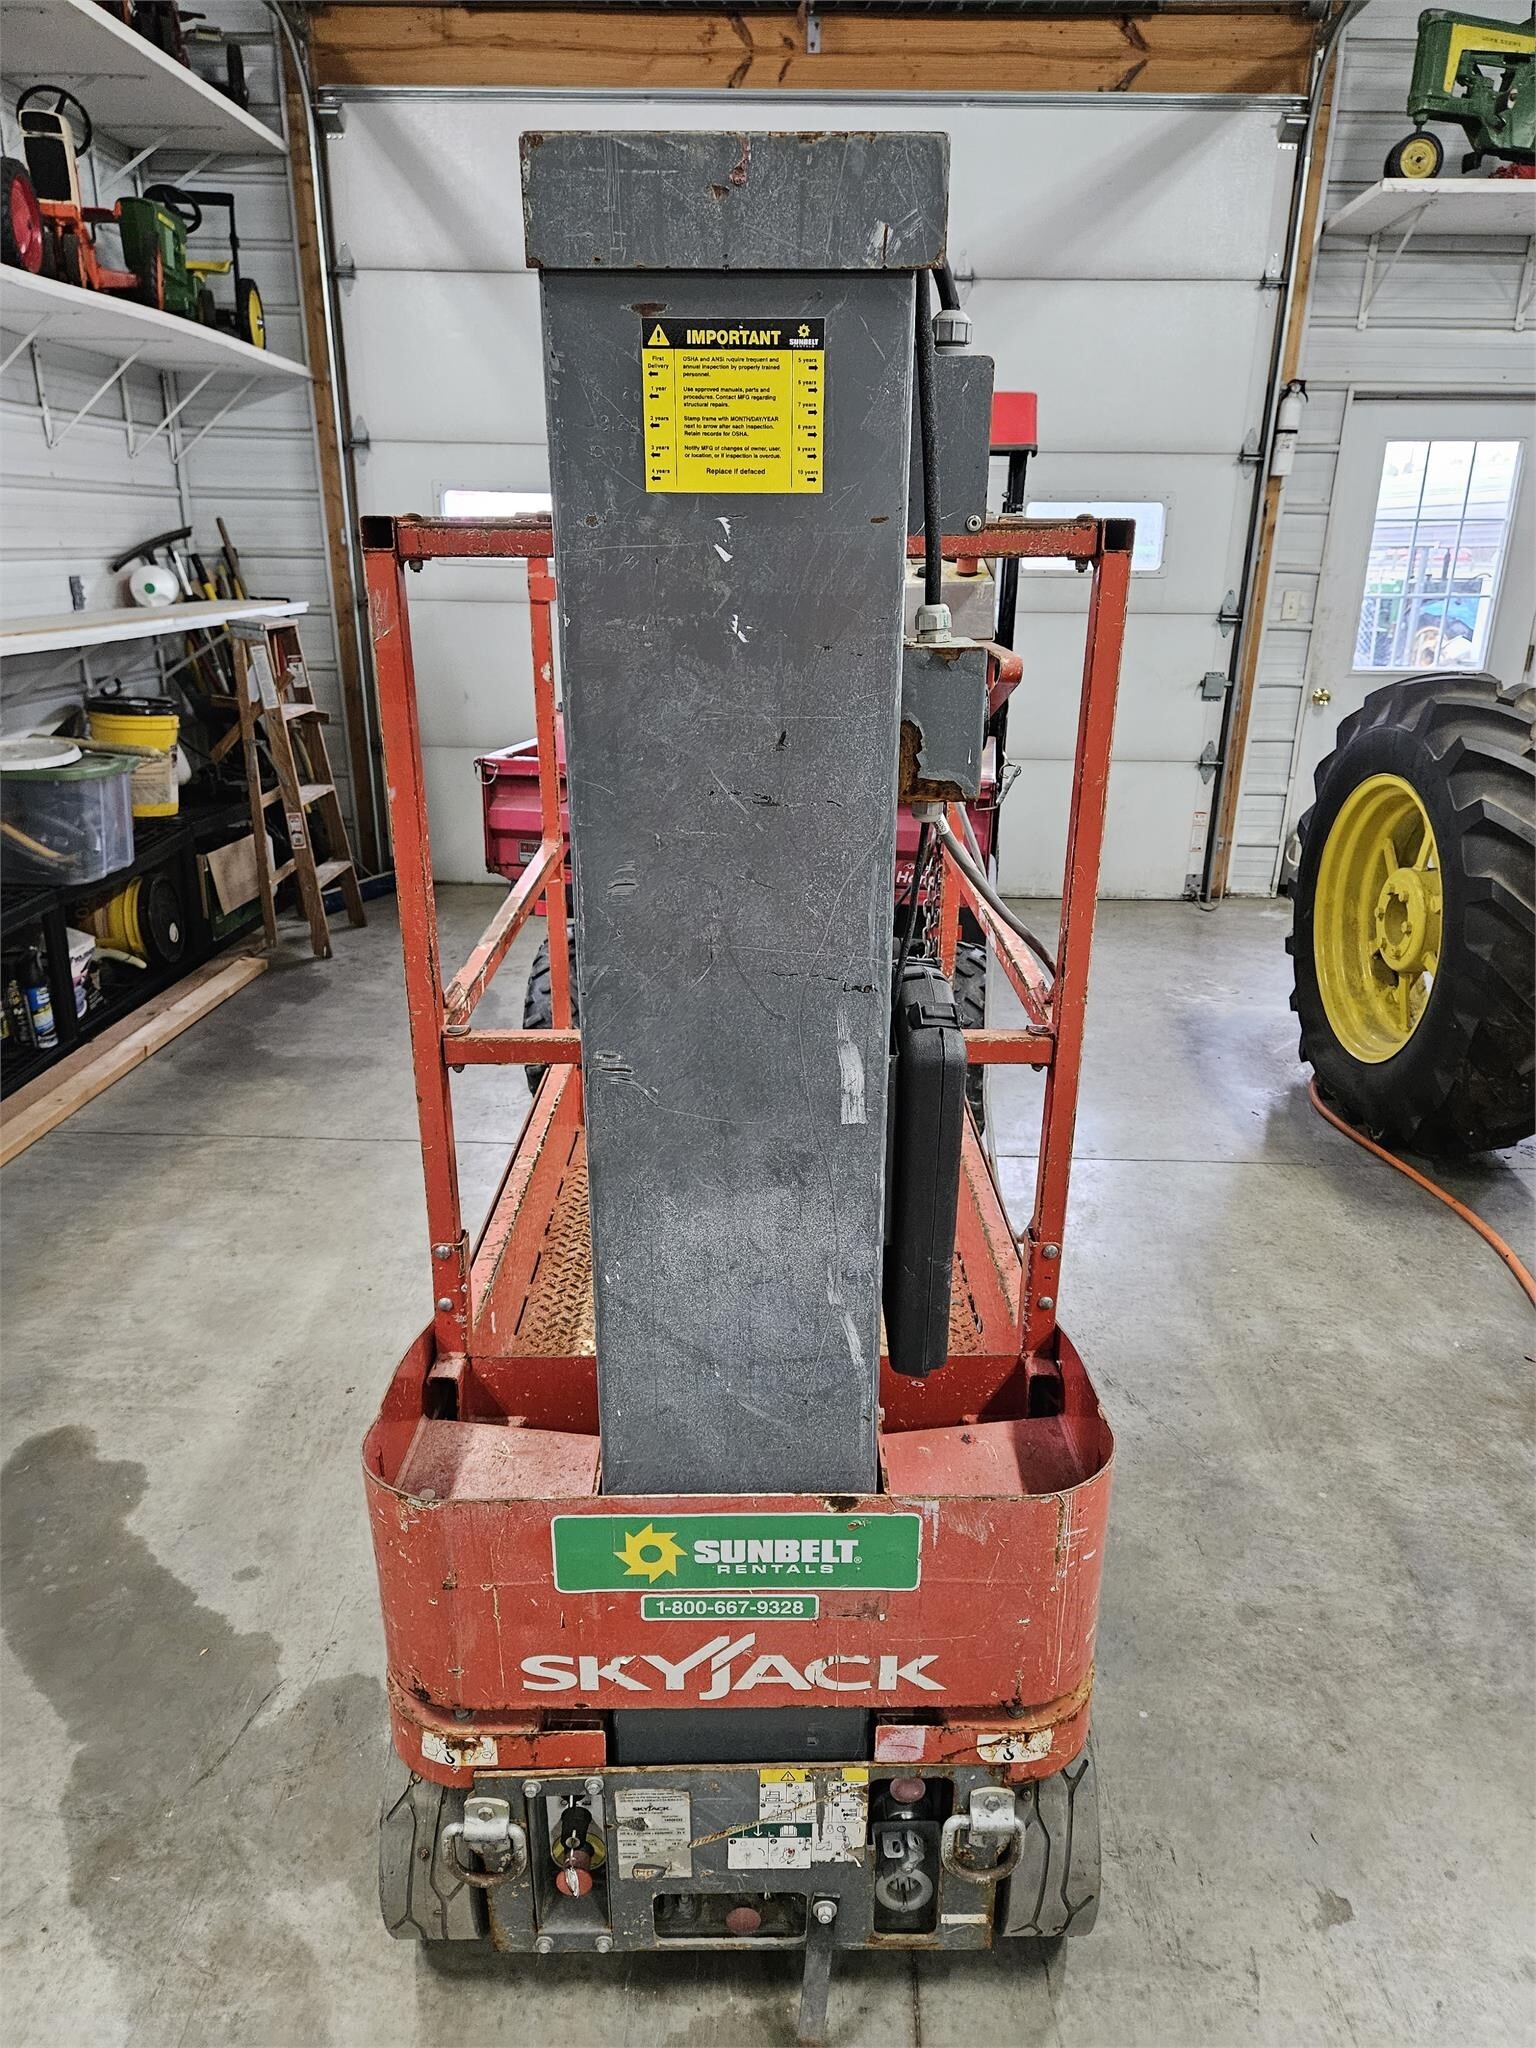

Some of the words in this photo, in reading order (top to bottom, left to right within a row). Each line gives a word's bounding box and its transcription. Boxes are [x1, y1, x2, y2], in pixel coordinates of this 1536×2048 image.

[686, 329, 781, 345] IMPORTANT
[693, 1539, 859, 1564] SUNBELT
[717, 1564, 834, 1574] RENTALS
[656, 1600, 804, 1616] 1-800-667-9328
[520, 1632, 947, 1700] SKYJACK
